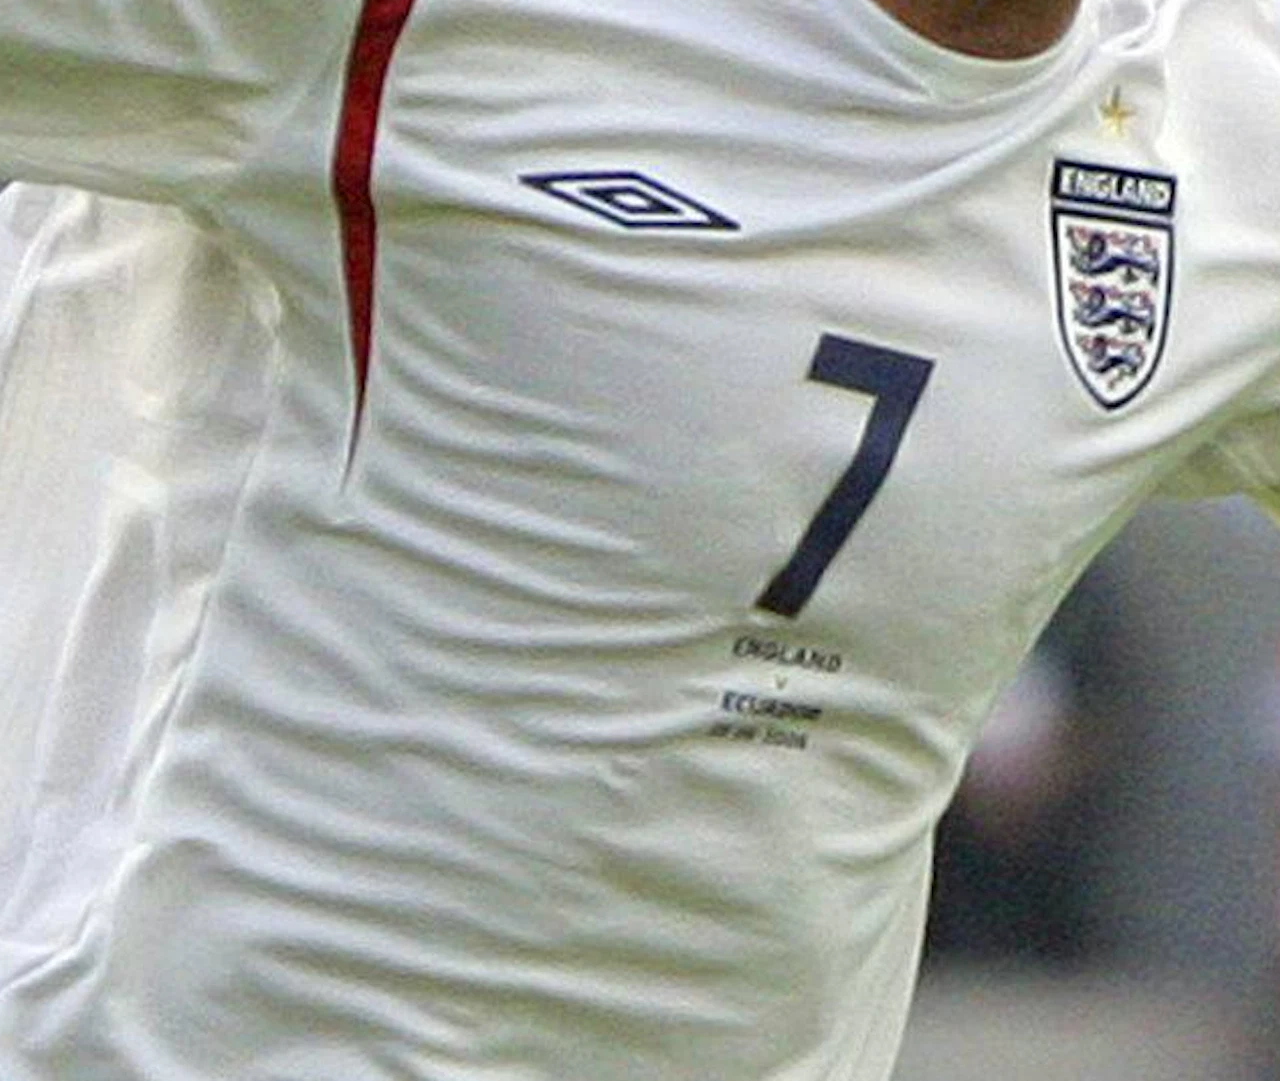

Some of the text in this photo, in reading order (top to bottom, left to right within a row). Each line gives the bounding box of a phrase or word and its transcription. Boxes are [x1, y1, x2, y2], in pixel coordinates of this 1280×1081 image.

[1061, 167, 1169, 207] ENGLAND
[754, 332, 936, 619] 7
[732, 635, 842, 672] ENGLAND
